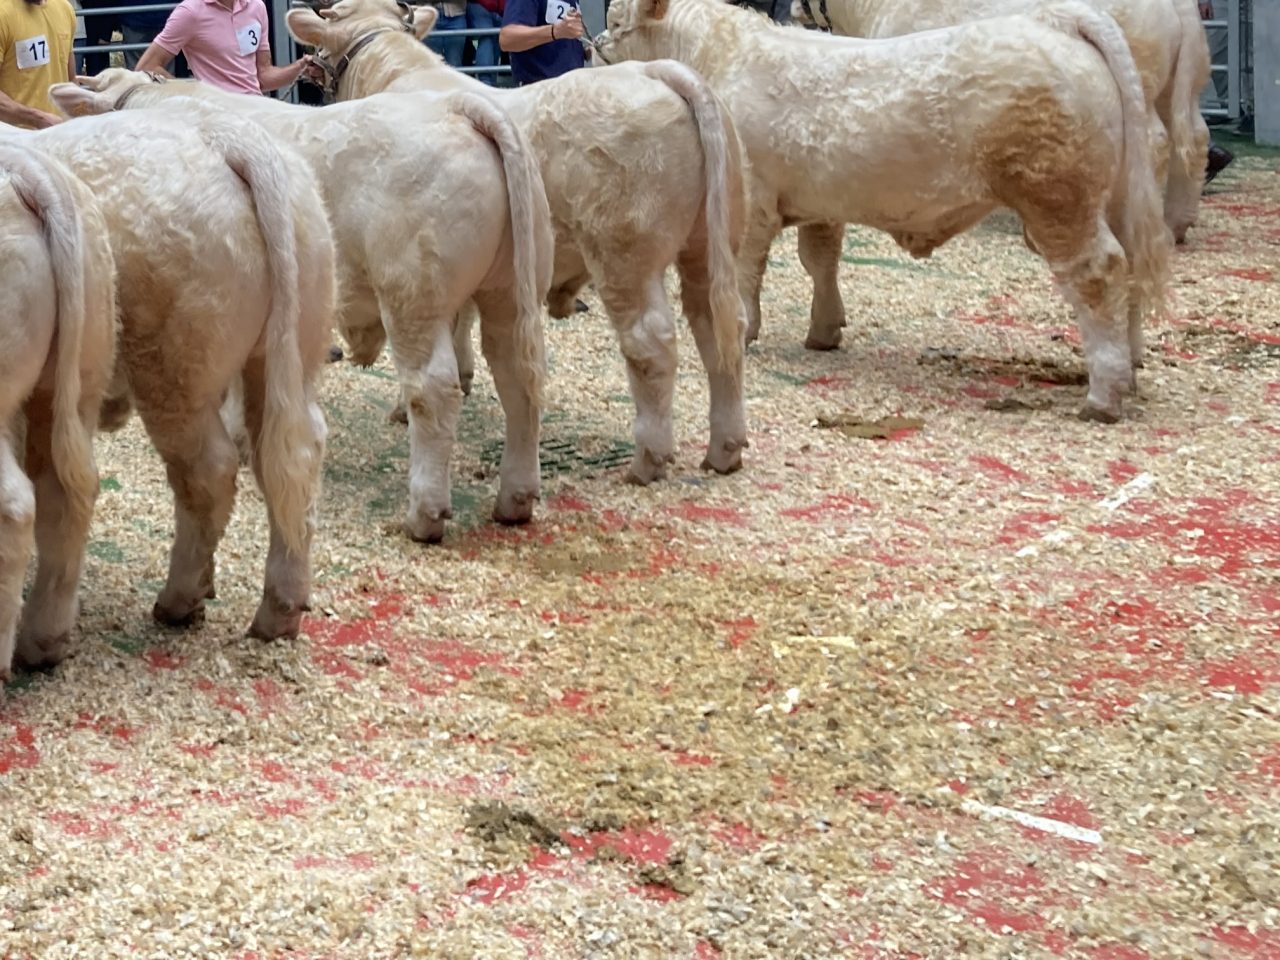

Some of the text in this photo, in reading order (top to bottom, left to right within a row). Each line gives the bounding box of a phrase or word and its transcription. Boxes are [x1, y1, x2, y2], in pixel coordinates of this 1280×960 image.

[556, 5, 565, 20] 2
[248, 29, 258, 46] 3
[28, 40, 46, 61] 17
